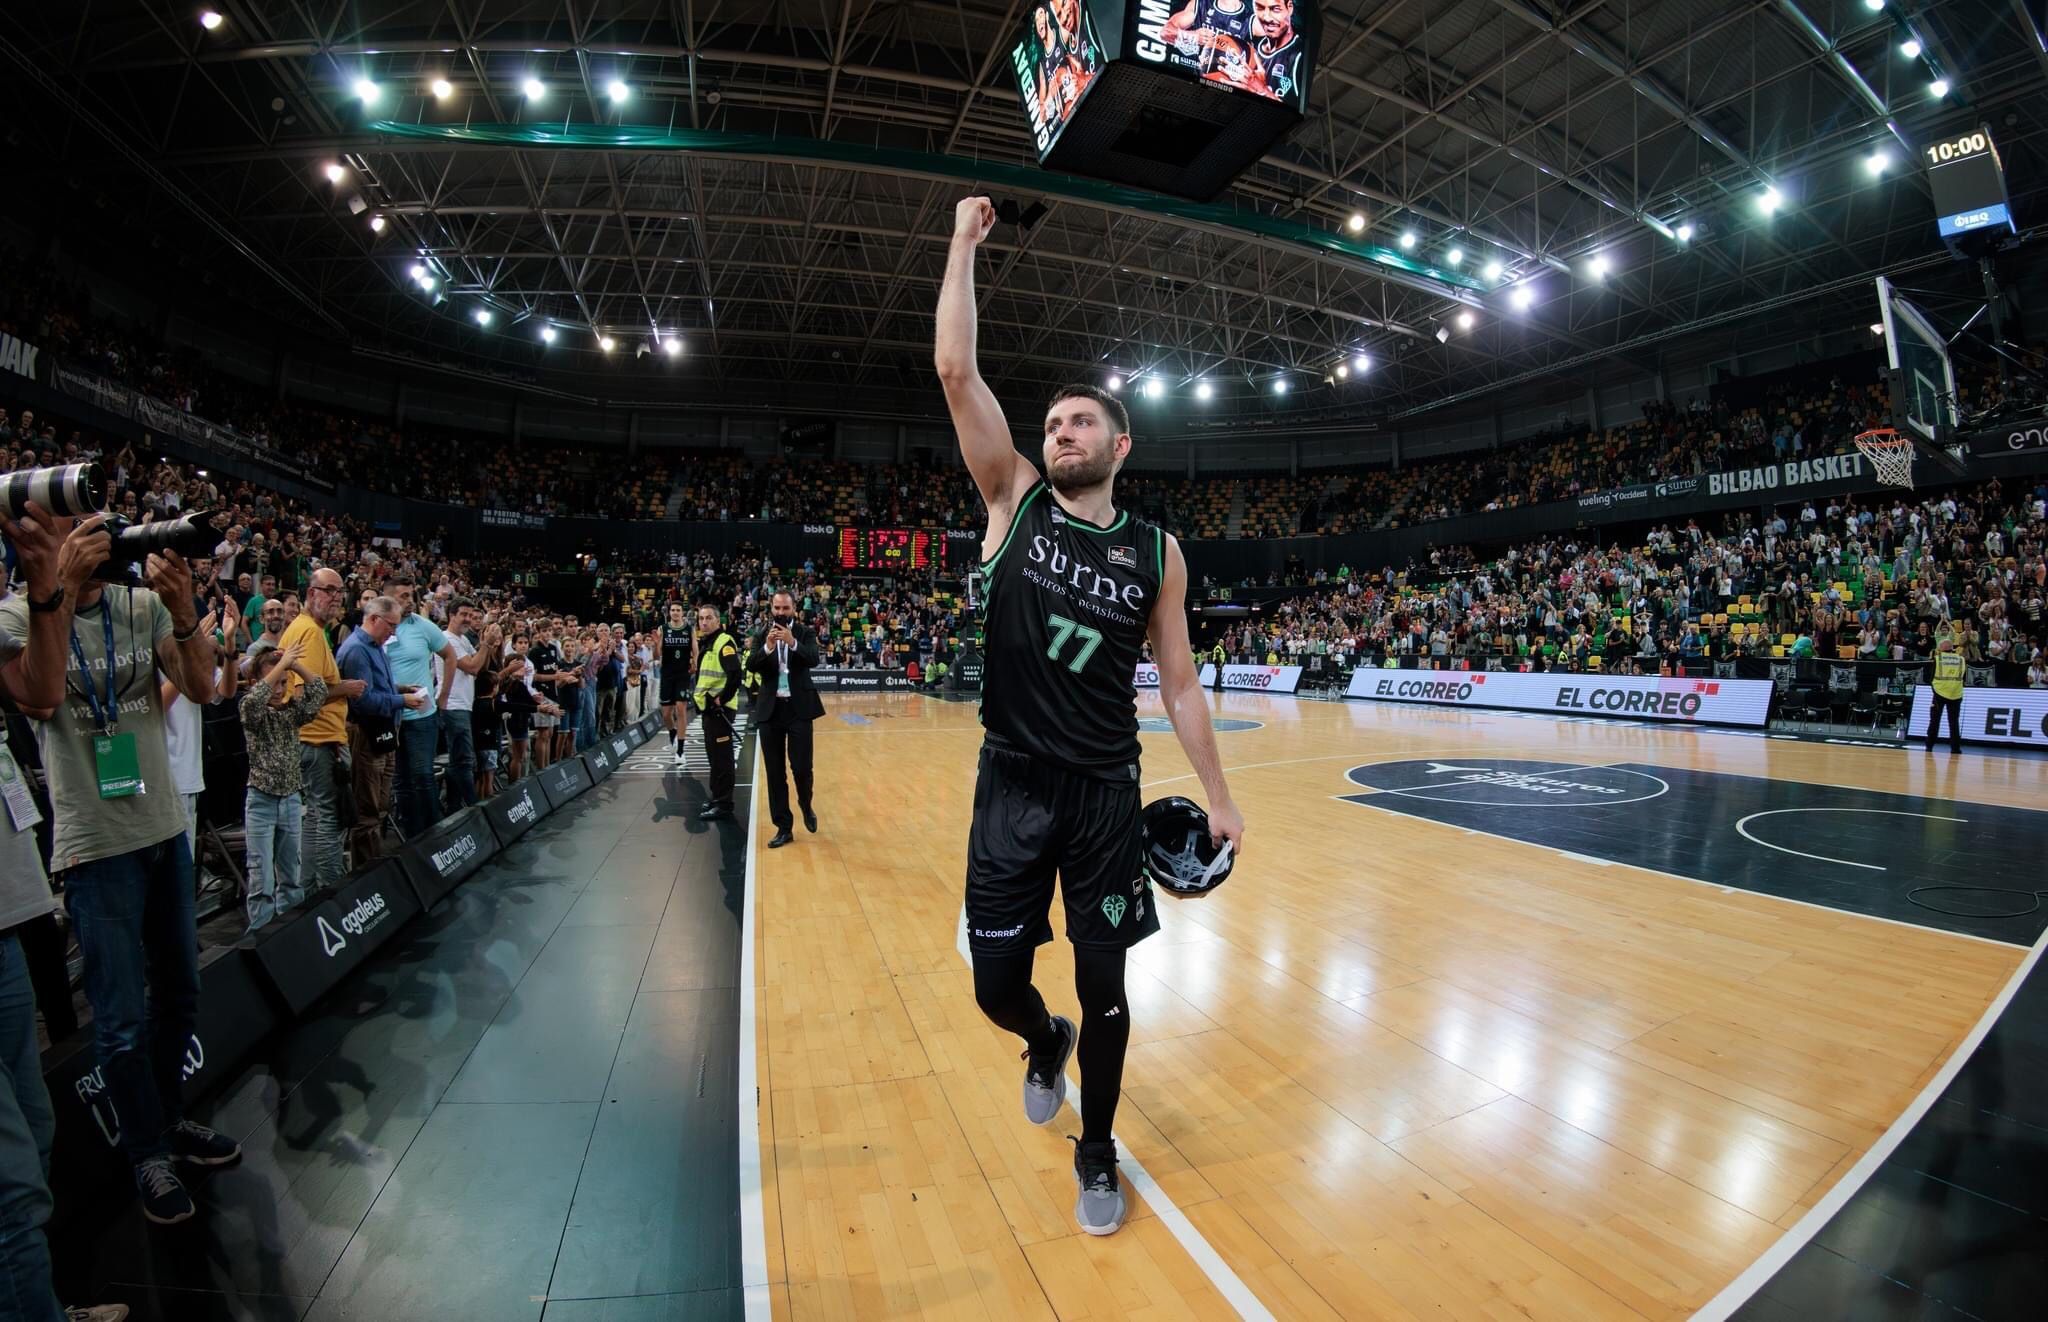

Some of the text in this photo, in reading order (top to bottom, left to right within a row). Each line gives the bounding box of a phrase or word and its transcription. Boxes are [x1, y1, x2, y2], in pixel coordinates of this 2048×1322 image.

[1012, 41, 1050, 151] GAMEDAY
[1927, 133, 1986, 163] 10:00
[1964, 212, 1989, 224] IMQ
[2008, 426, 2048, 450] en
[1709, 452, 1863, 495] BILBAO BASKET
[1667, 479, 1697, 491] surne
[1578, 492, 1611, 507] vueling
[1619, 490, 1648, 500] Occident
[803, 525, 825, 534] bbk
[947, 530, 967, 539] bbk
[1111, 555, 1135, 565] endesa
[514, 574, 521, 583] B
[1022, 567, 1067, 595] seguros
[1028, 536, 1144, 611] surne
[1210, 589, 1217, 598] C
[1078, 599, 1137, 626] pensiones
[1047, 613, 1104, 673] 77
[94, 645, 153, 670] nbody
[675, 650, 680, 659] 8
[849, 677, 878, 686] Petronor
[1227, 673, 1271, 687] CORREO
[1375, 679, 1472, 700] EL CORREO
[1555, 687, 1701, 716] EL CORREO
[1984, 707, 2032, 737] EL
[342, 892, 385, 935] agaleus
[975, 928, 1021, 938] EL CORREO
